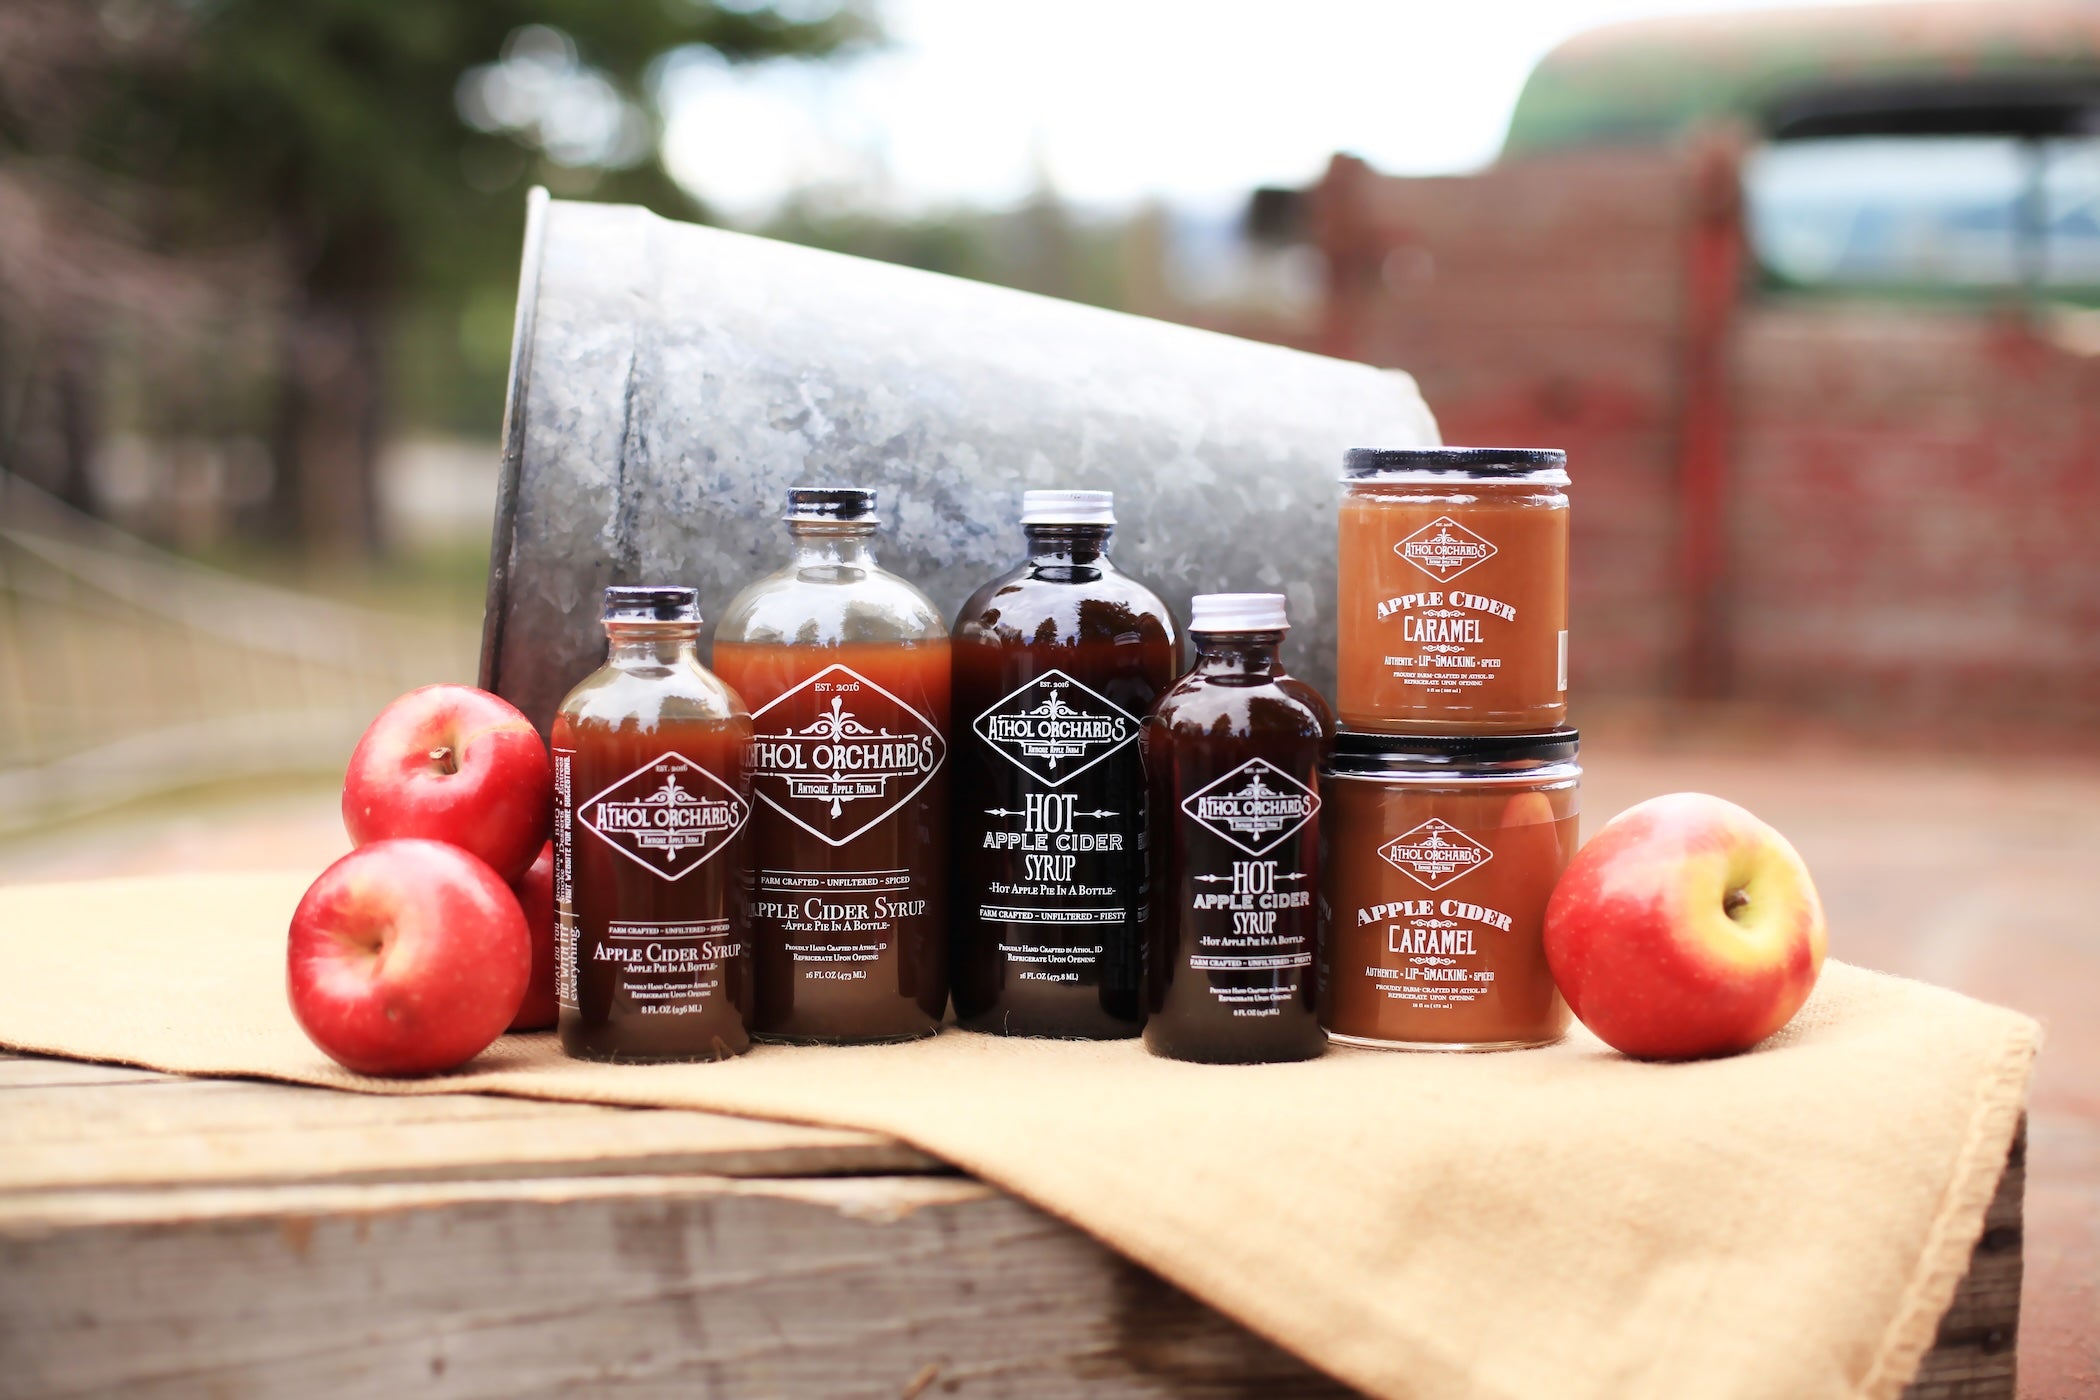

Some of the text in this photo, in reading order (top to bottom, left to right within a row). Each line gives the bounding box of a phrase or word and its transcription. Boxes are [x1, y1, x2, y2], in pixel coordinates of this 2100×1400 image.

[1405, 542, 1487, 558] ATHOL ORCHARDS
[1377, 590, 1518, 622] APPLE CIDER
[1404, 615, 1484, 644] CARAMEL
[1418, 654, 1476, 668] LIP-SMACKING
[1481, 658, 1501, 668] SPICED
[814, 682, 860, 692] EST. 2016
[988, 716, 1126, 742] ATHOL ORCHARDS
[749, 735, 934, 773] THOL ORCHARDS
[797, 782, 876, 794] ANTIQUE APPLE FARM
[596, 801, 739, 830] ATHOL ORCHARDS
[1025, 793, 1078, 833] HOT
[1198, 795, 1311, 819] ATHOL ORCHARDS
[983, 831, 1123, 852] APPLE CIDER
[1390, 845, 1481, 863] ATHOL ORCHARDS
[1024, 854, 1076, 882] SYRUP
[1232, 860, 1278, 894] HOT
[761, 876, 910, 887] FARM CRAFTED UNFILTERED SPICED
[1011, 883, 1038, 895] APPLE
[1040, 884, 1055, 896] PIE
[1056, 885, 1067, 896] IN
[1068, 885, 1077, 896] A
[804, 897, 869, 920] CIDER
[875, 896, 925, 919] SYRUP
[1193, 891, 1310, 910] APPLE CIDER
[979, 909, 1126, 921] FARM CRAFTED UNFILTERED FIESTY
[1233, 911, 1277, 935] SYRUP
[1357, 899, 1513, 932] APPLE CIDER
[814, 920, 829, 931] PIE
[831, 920, 841, 931] IN
[843, 920, 852, 931] A
[785, 943, 809, 951] PROUDLY
[827, 944, 851, 952] CRAFTED
[1388, 924, 1477, 955] CARAMEL
[555, 946, 561, 961] DO
[593, 941, 741, 962] APPLE CIDER SYRUP
[793, 953, 879, 961] REFRIGERATE UPON OPENING
[1007, 953, 1096, 963] REFRIGERATE UPON OPENING
[560, 923, 570, 999] DO WITH IT?
[653, 963, 667, 973] PIE
[668, 963, 678, 972] IN
[678, 963, 686, 972] A
[806, 971, 867, 981] 16 FL OZ (473 ML)
[1365, 966, 1495, 981] AUTHENTIC LIP-SMACKING SPICED
[641, 1006, 647, 1014] 8
